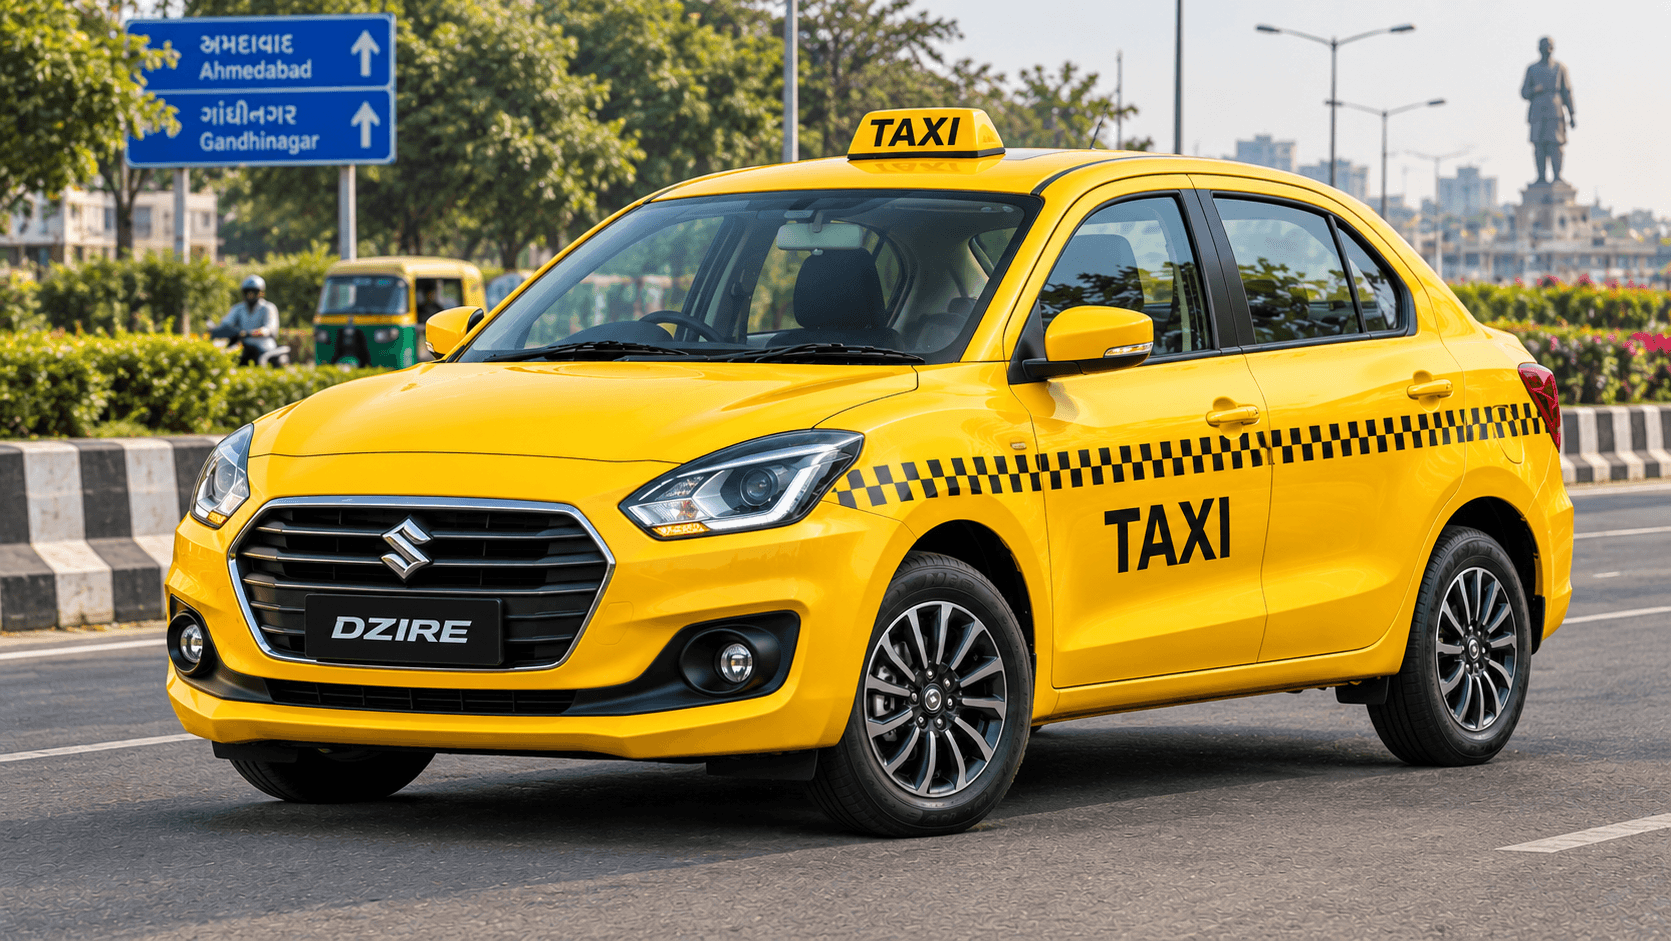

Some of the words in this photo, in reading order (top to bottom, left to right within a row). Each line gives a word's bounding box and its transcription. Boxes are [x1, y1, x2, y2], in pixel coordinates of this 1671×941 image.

[200, 34, 293, 54] અમદાવાદ
[199, 59, 312, 80] Ahmedabad
[200, 131, 320, 155] Gandhinagar
[870, 117, 960, 147] TAXI
[1104, 496, 1230, 573] TAXI
[331, 616, 473, 643] DZIRE
